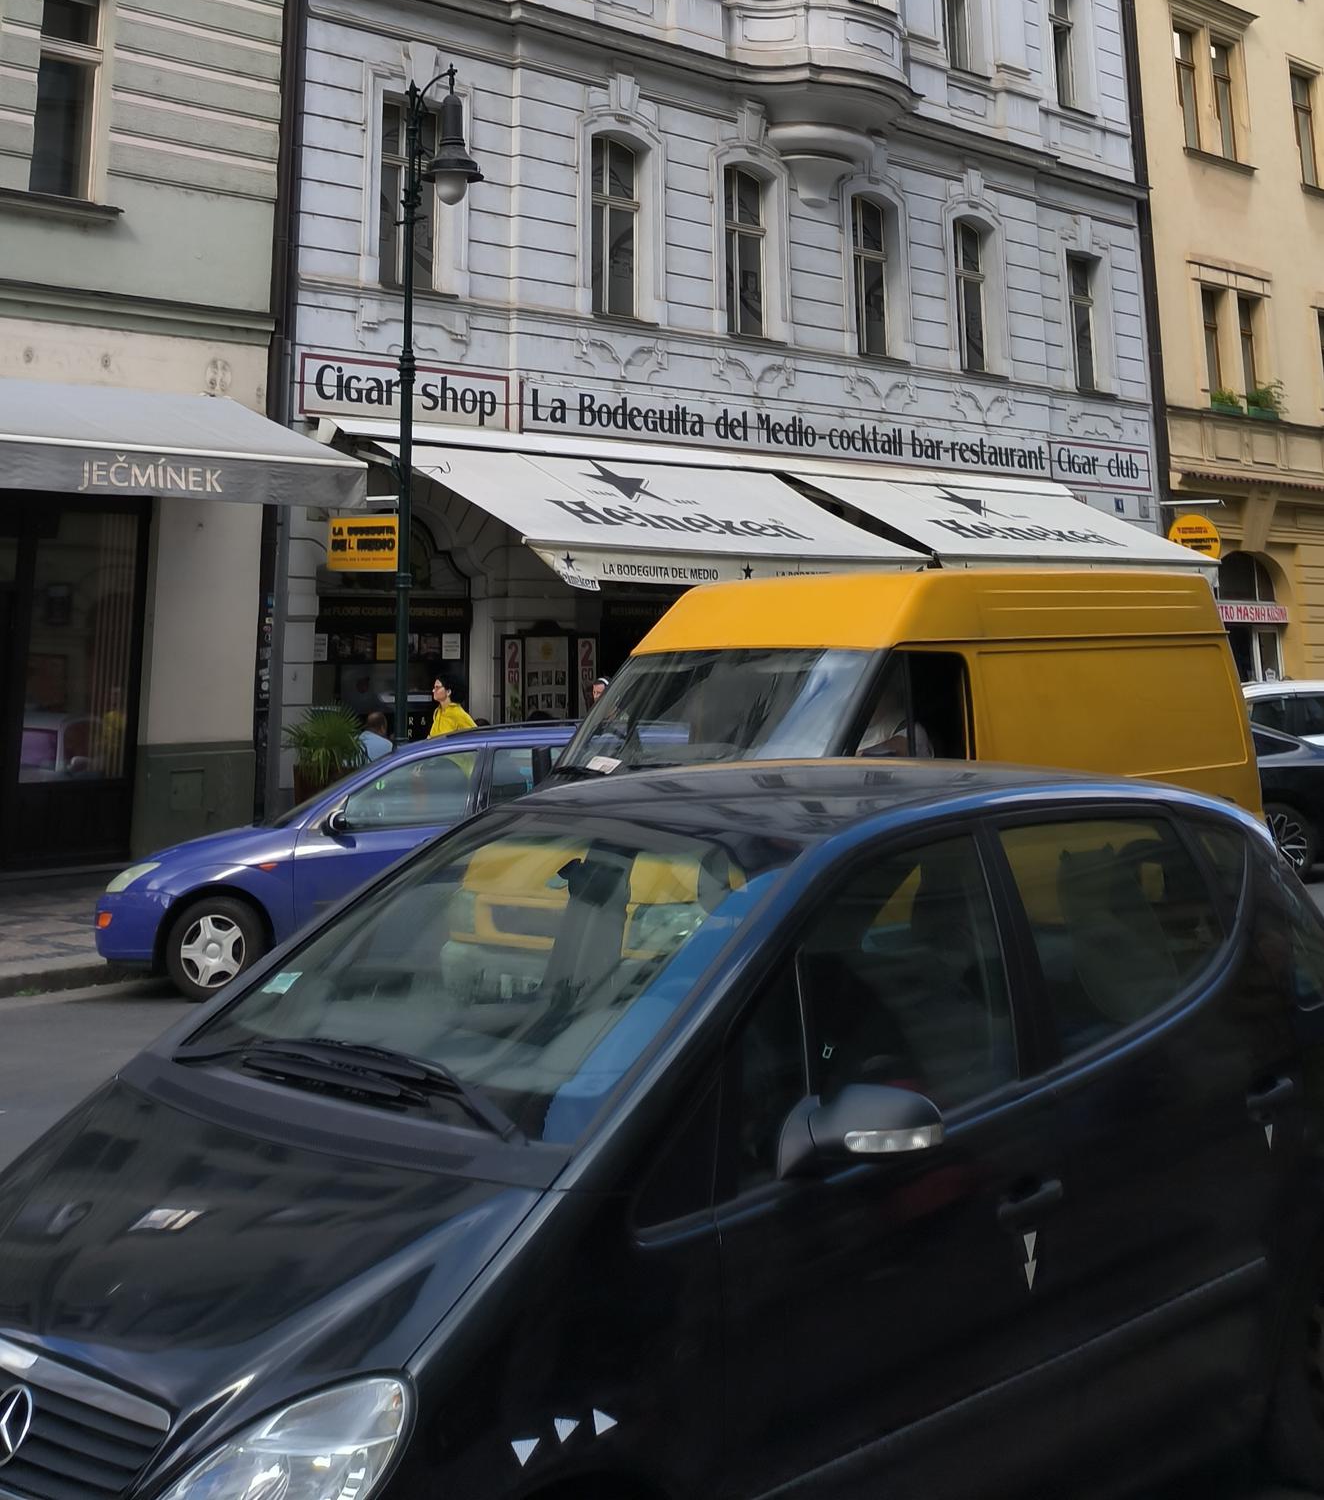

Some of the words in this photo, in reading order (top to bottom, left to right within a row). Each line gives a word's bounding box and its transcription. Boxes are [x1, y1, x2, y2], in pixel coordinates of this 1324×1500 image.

[315, 364, 400, 406] Cigar
[421, 376, 496, 426] shop
[531, 388, 567, 424] La
[578, 392, 704, 438] Bodeguita
[715, 408, 748, 442] del
[77, 453, 223, 493] JEČMÍNEK
[1057, 447, 1098, 476] Cigar
[1107, 452, 1139, 480] club
[544, 498, 815, 541] Heineken
[927, 519, 1128, 548] Heineken
[602, 563, 615, 575] LA
[617, 564, 670, 579] BODEGUITA
[672, 567, 689, 579] DEL
[690, 569, 719, 581] MEDIO
[508, 641, 520, 668] 2
[581, 640, 593, 667] 2
